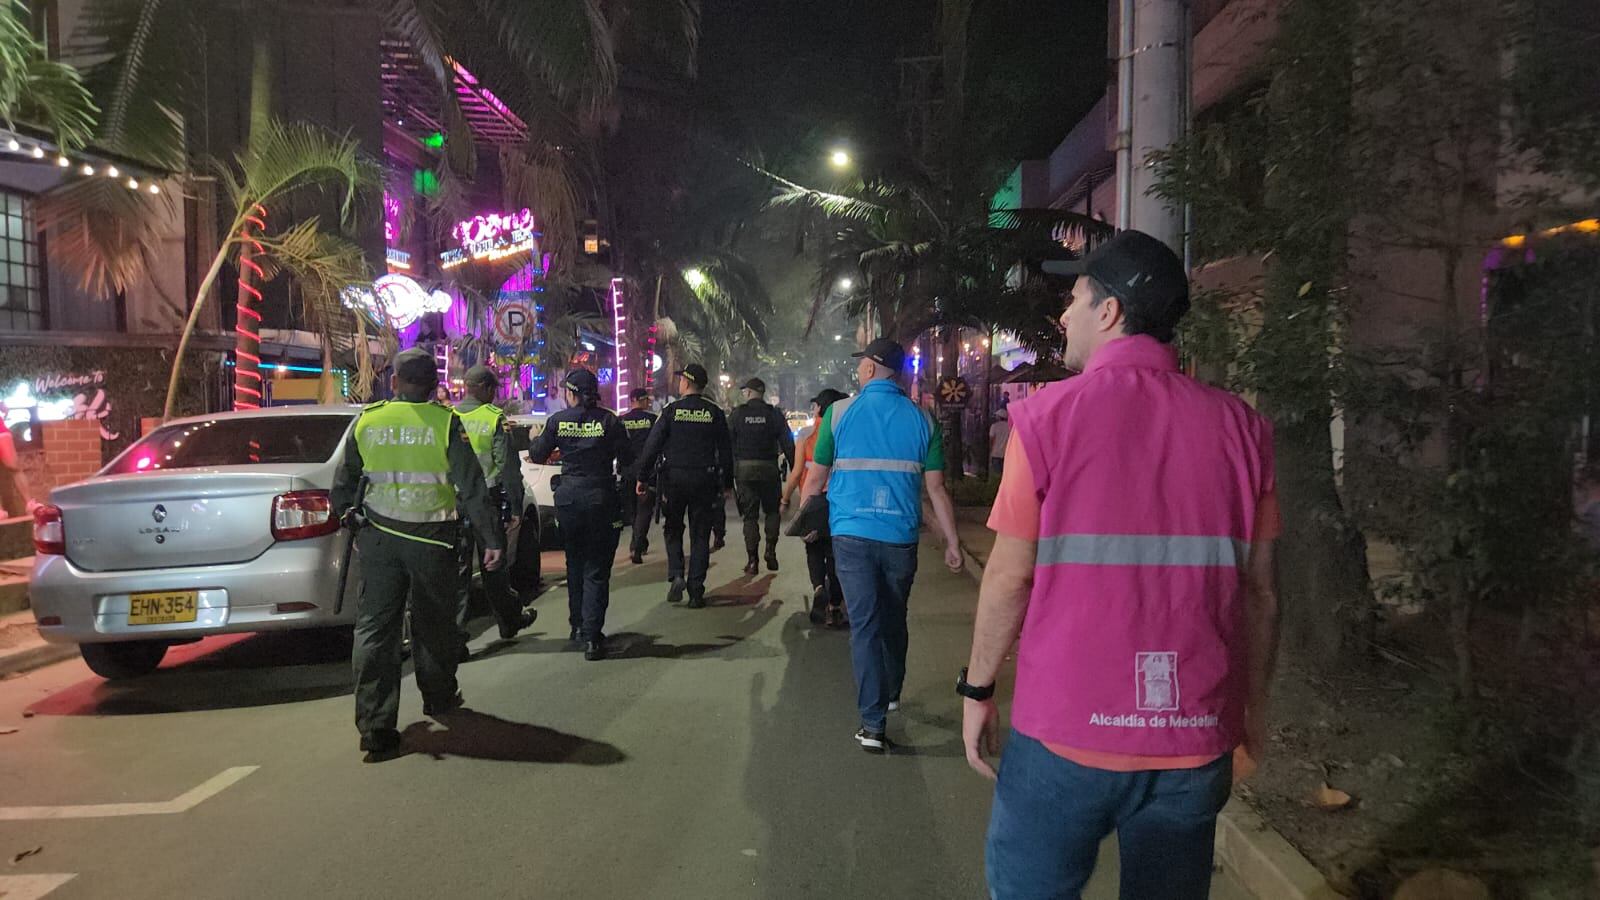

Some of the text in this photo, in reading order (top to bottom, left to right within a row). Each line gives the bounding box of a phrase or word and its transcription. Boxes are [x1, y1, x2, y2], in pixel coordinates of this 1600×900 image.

[509, 311, 526, 335] P
[36, 374, 91, 393] Welcome
[675, 408, 711, 418] POLICÍA
[558, 420, 603, 432] POLICÍA
[130, 596, 194, 617] EHN-354
[1089, 713, 1146, 727] Alcaldía
[1149, 715, 1167, 728] de
